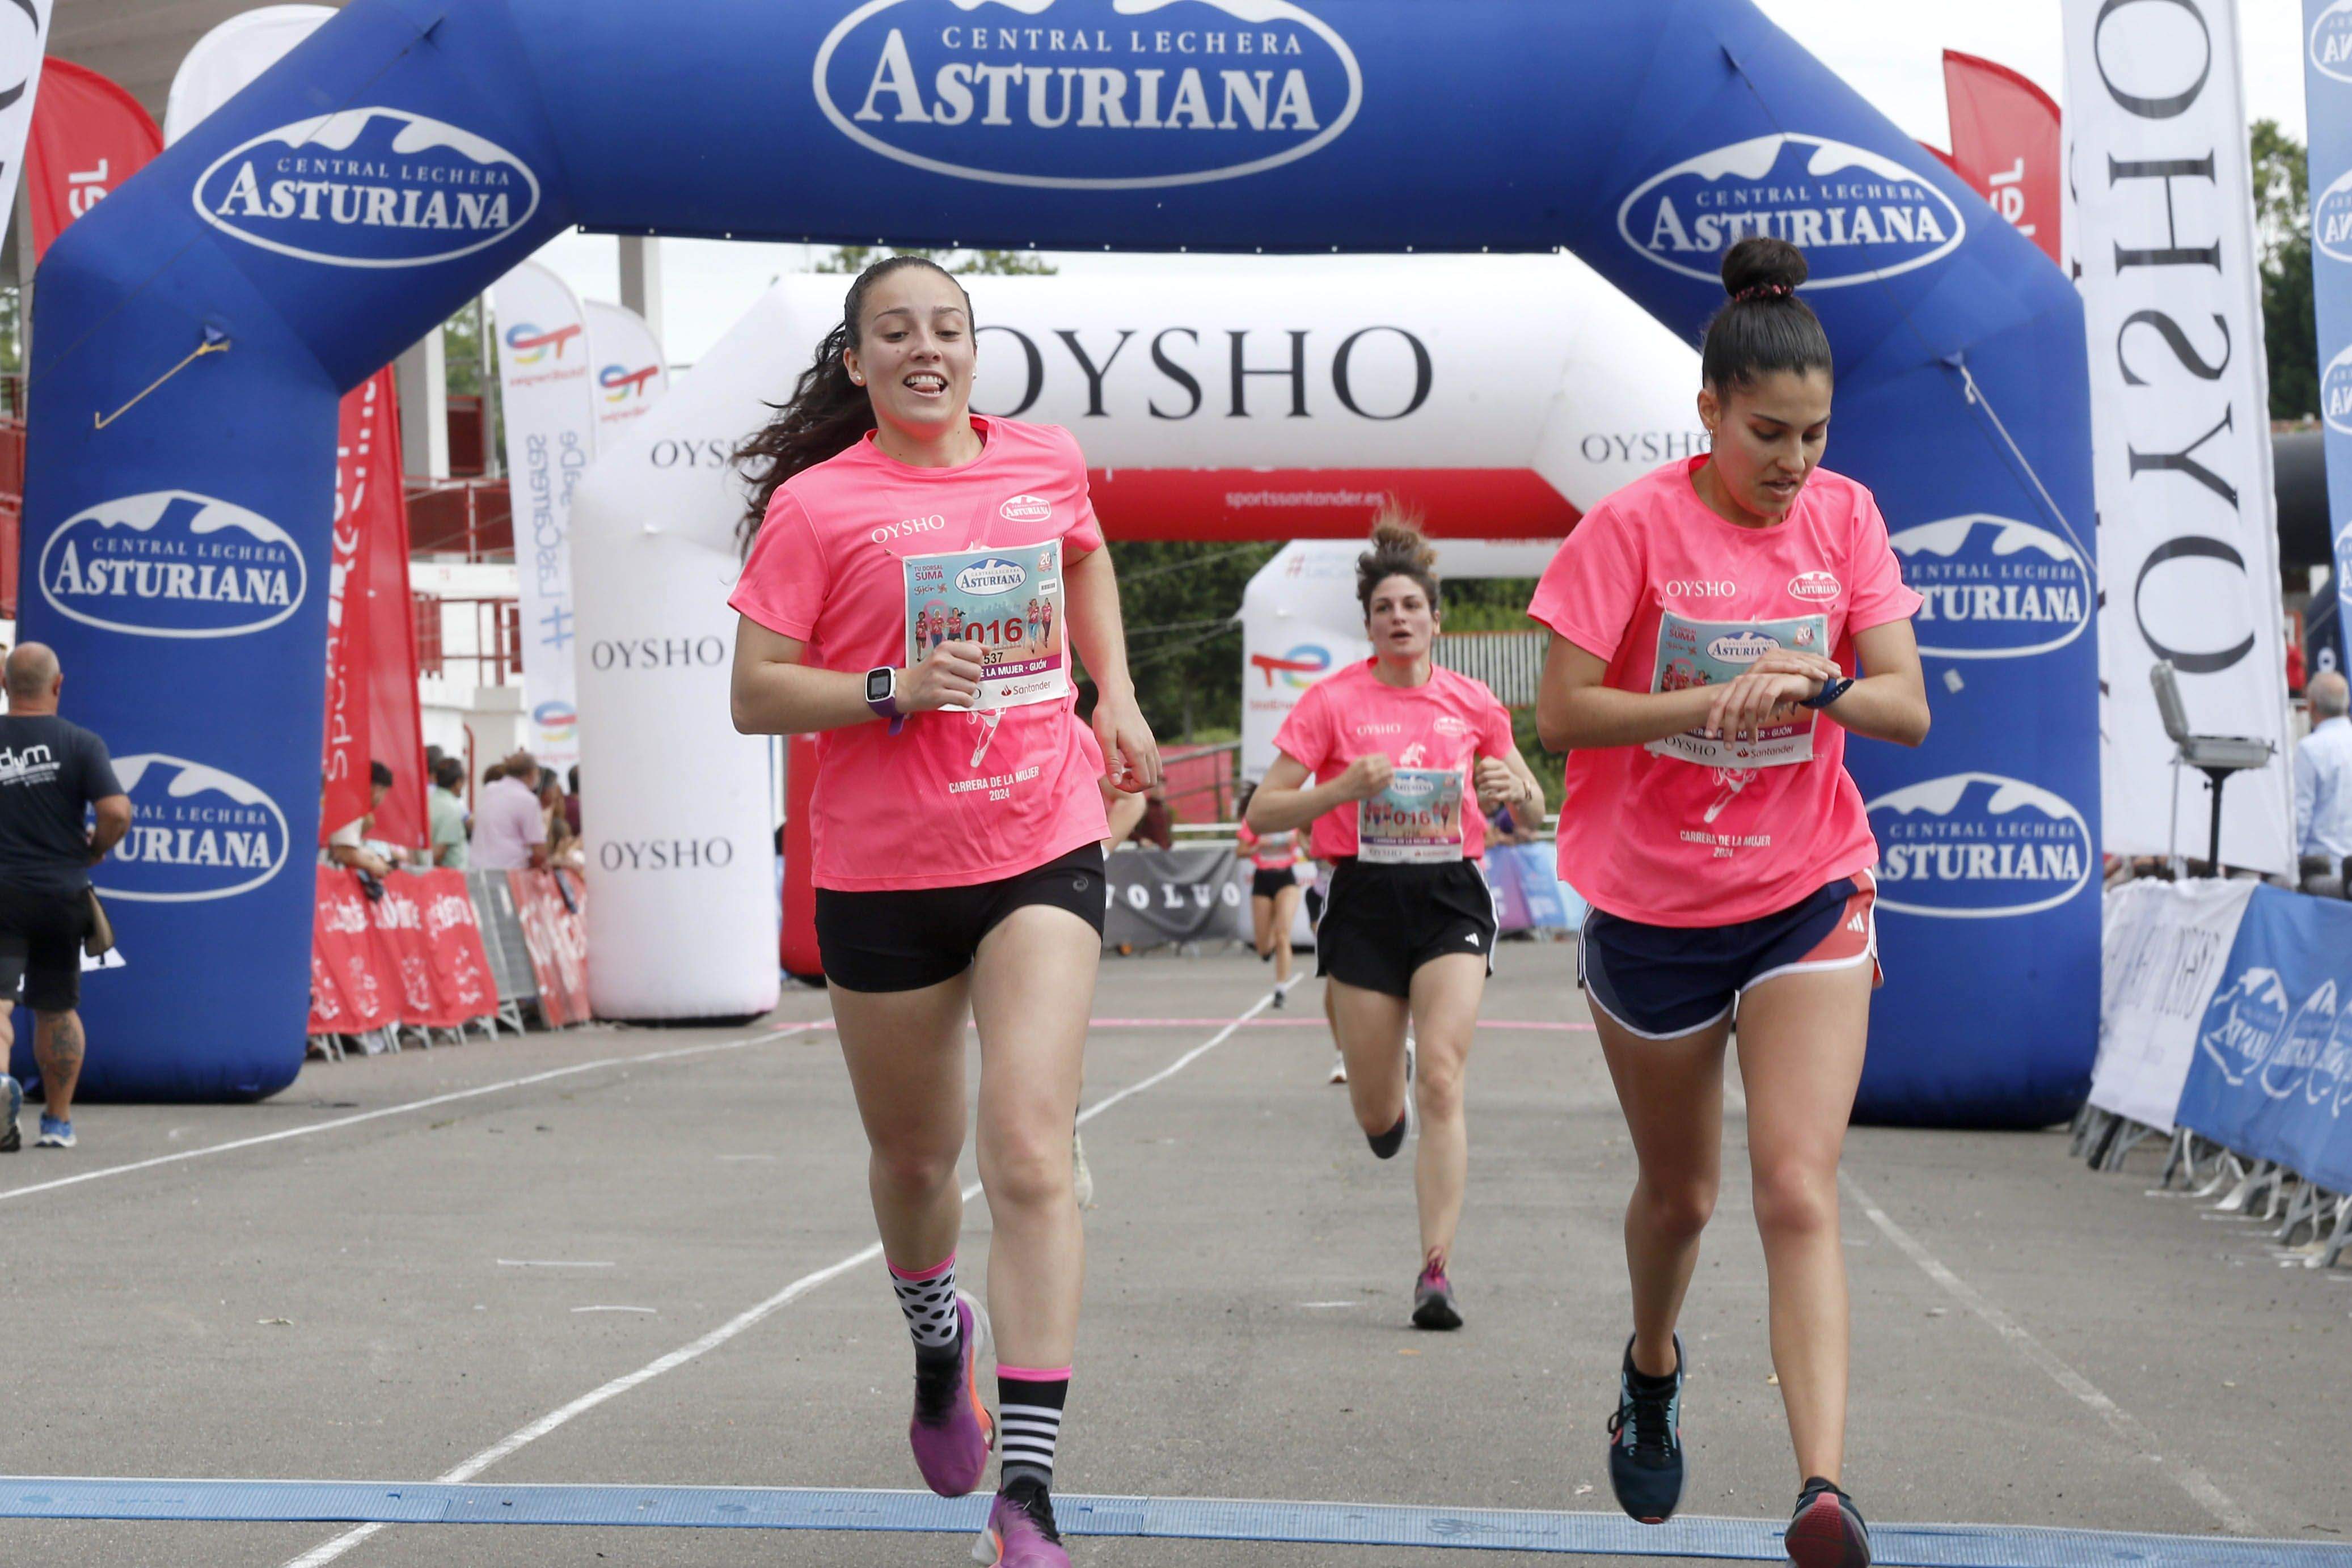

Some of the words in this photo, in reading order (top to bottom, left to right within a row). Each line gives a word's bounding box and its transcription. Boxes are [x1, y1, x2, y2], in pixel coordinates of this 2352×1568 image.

[943, 26, 1112, 52] CENTRAL
[1131, 31, 1303, 54] LECHERA
[854, 28, 1319, 130] ASTURIANA
[277, 157, 389, 179] CENTRAL
[400, 164, 510, 186] LECHERA
[216, 160, 510, 229] ASTURIANA
[1696, 185, 1811, 206] CENTRAL
[1822, 183, 1925, 202] LECHERA
[1648, 196, 1946, 253] ASTURIANA
[871, 514, 945, 543] OYSHO
[93, 537, 188, 556] CENTRAL
[197, 543, 286, 563] LECHERA
[52, 539, 290, 606] ASTURIANA
[915, 571, 944, 581] SUMA
[960, 573, 1021, 589] ASTURIANA
[2001, 563, 2077, 580] LECHERA
[1666, 580, 1736, 597] OYSHO
[592, 636, 724, 670] OYSHO
[986, 667, 996, 677] LA
[998, 665, 1024, 675] MUJER
[1029, 659, 1047, 671] GIJÓN
[1013, 681, 1052, 695] Santander
[1665, 736, 1716, 758] OYSHO
[1750, 743, 1794, 759] Santander
[949, 778, 989, 793] CARRERA
[990, 776, 1002, 787] DE
[1003, 774, 1014, 785] LA
[1015, 766, 1040, 783] MUJER
[989, 788, 1010, 801] 2024
[175, 806, 267, 825] LECHERA
[1680, 830, 1717, 844] CARRERA
[1718, 835, 1730, 846] DE
[1732, 835, 1741, 847] LA
[1743, 835, 1771, 847] MUJER
[1889, 822, 1987, 838] CENTRAL
[1995, 822, 2077, 838] LECHERA
[599, 836, 733, 872] OYSHO
